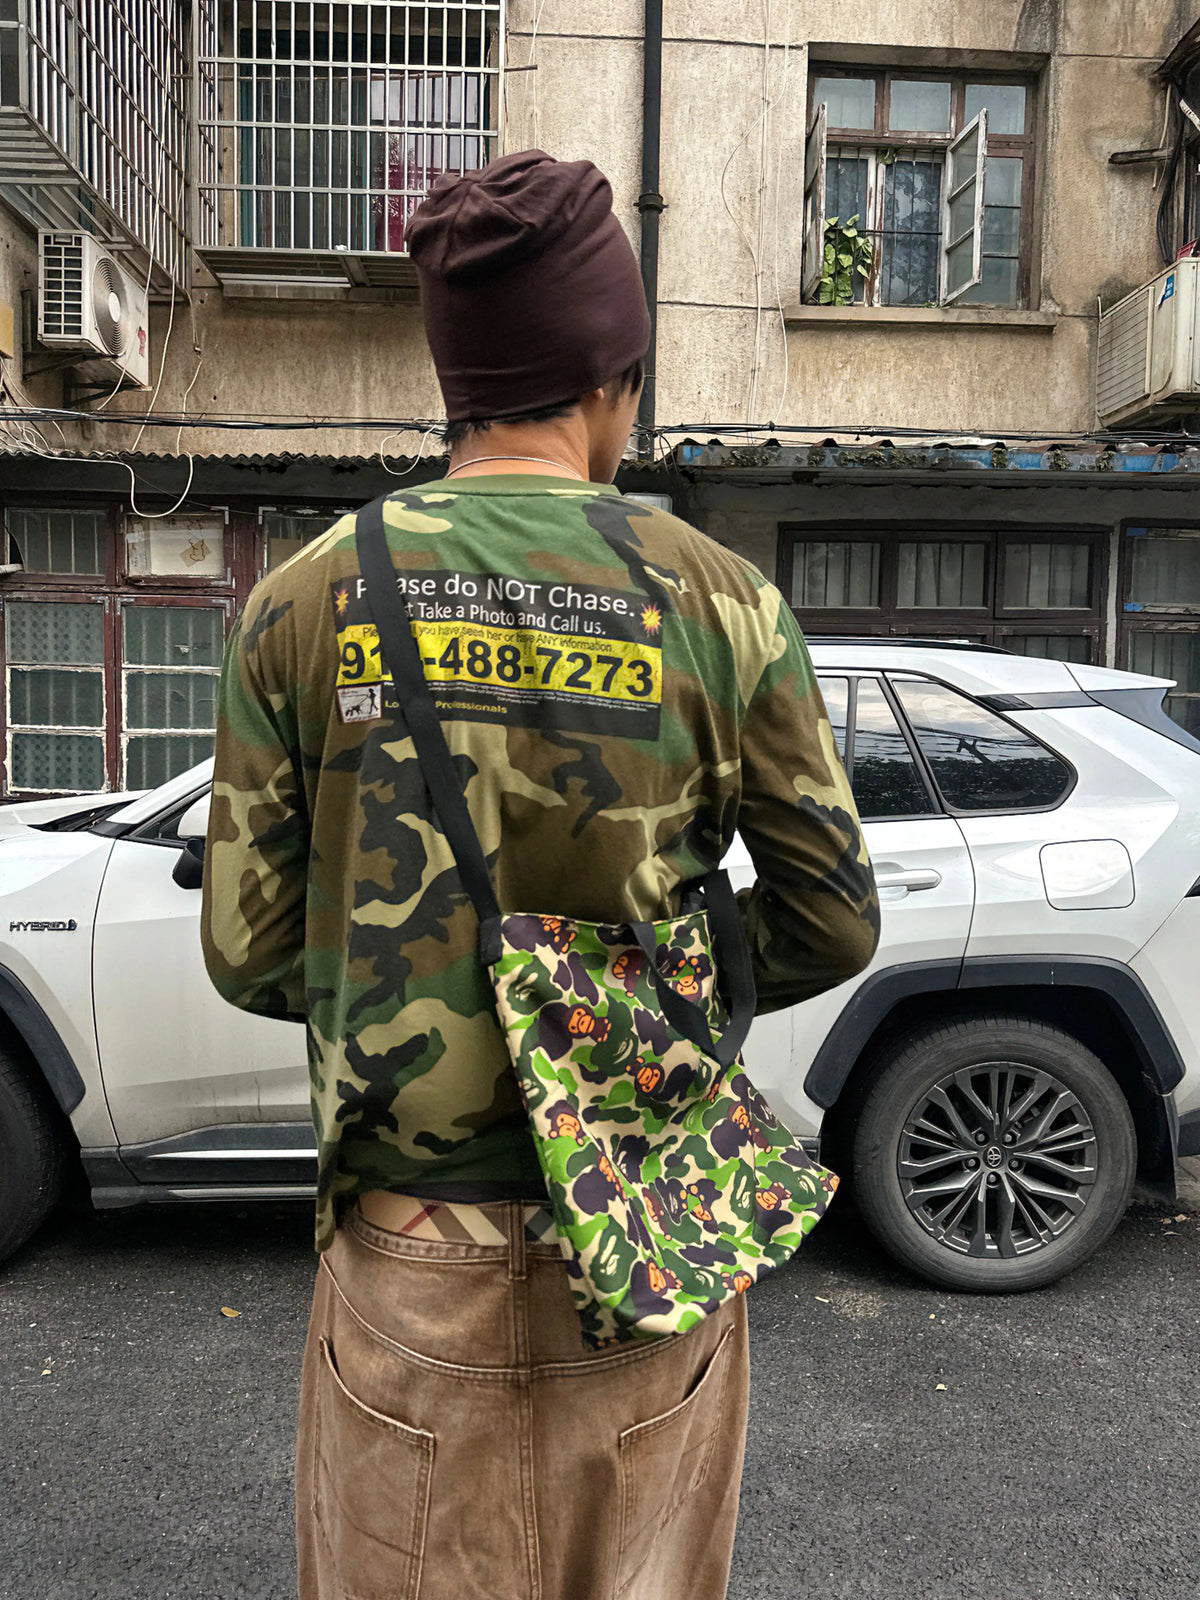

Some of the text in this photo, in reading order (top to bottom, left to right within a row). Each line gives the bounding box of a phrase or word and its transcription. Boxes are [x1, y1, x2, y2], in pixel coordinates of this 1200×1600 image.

[356, 573, 635, 617] Pase do NOT Chase.
[417, 602, 452, 620] Take
[456, 605, 465, 618] a
[470, 604, 515, 626] Photo
[518, 612, 546, 629] and
[551, 614, 579, 633] Call
[584, 620, 607, 636] us.
[419, 626, 436, 637] you
[438, 624, 460, 636] have
[461, 626, 484, 638] seen
[487, 630, 502, 642] her
[536, 634, 558, 647] ANY
[341, 637, 653, 697] 91-488-7273
[9, 921, 67, 932] HYBRID
